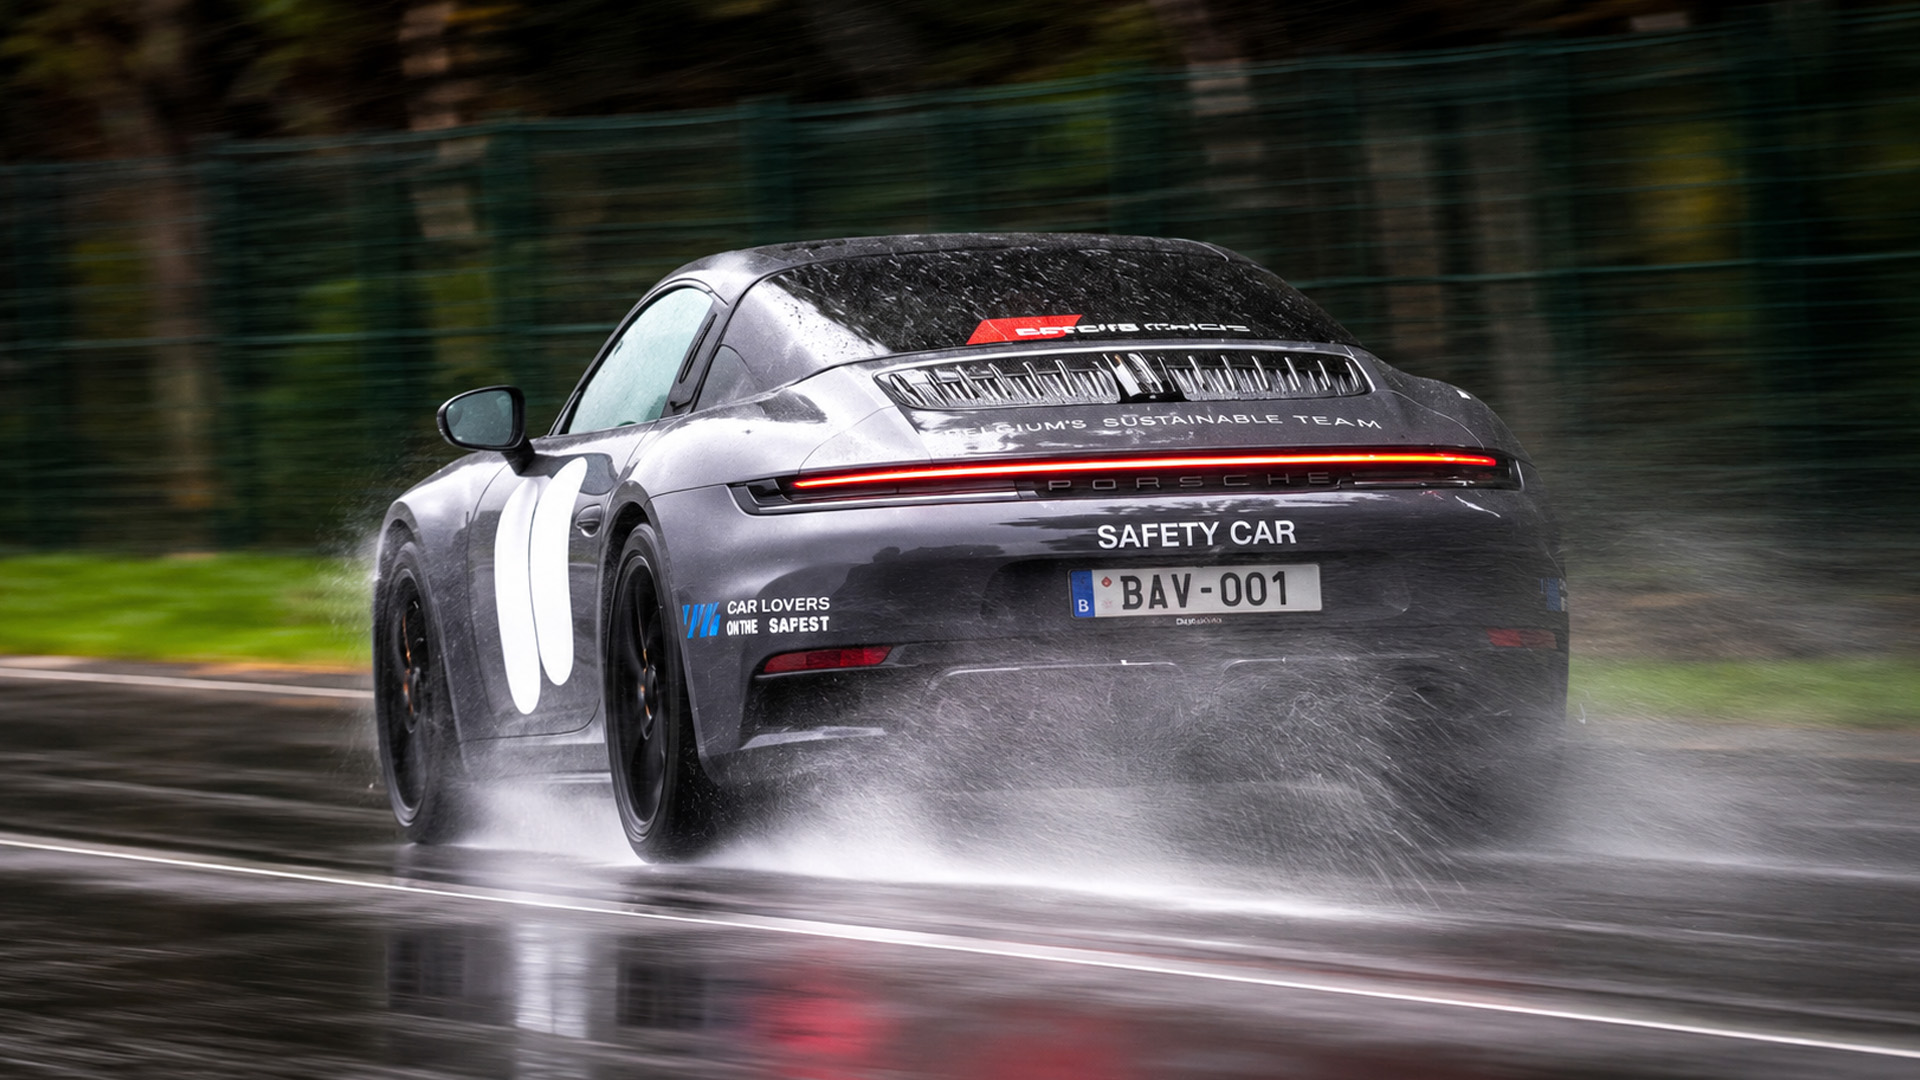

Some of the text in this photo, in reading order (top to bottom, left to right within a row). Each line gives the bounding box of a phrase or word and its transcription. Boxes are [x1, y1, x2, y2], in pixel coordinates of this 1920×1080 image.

[943, 414, 1382, 438] ELGIUM'S SUSTAINABLE TEAM
[1048, 471, 1330, 491] PORSCHE
[1097, 519, 1297, 549] SAFETY CAR
[1120, 570, 1288, 610] BAV-001
[727, 596, 830, 615] CAR LOVERS
[1078, 599, 1090, 613] B
[768, 615, 830, 634] SAFEST
